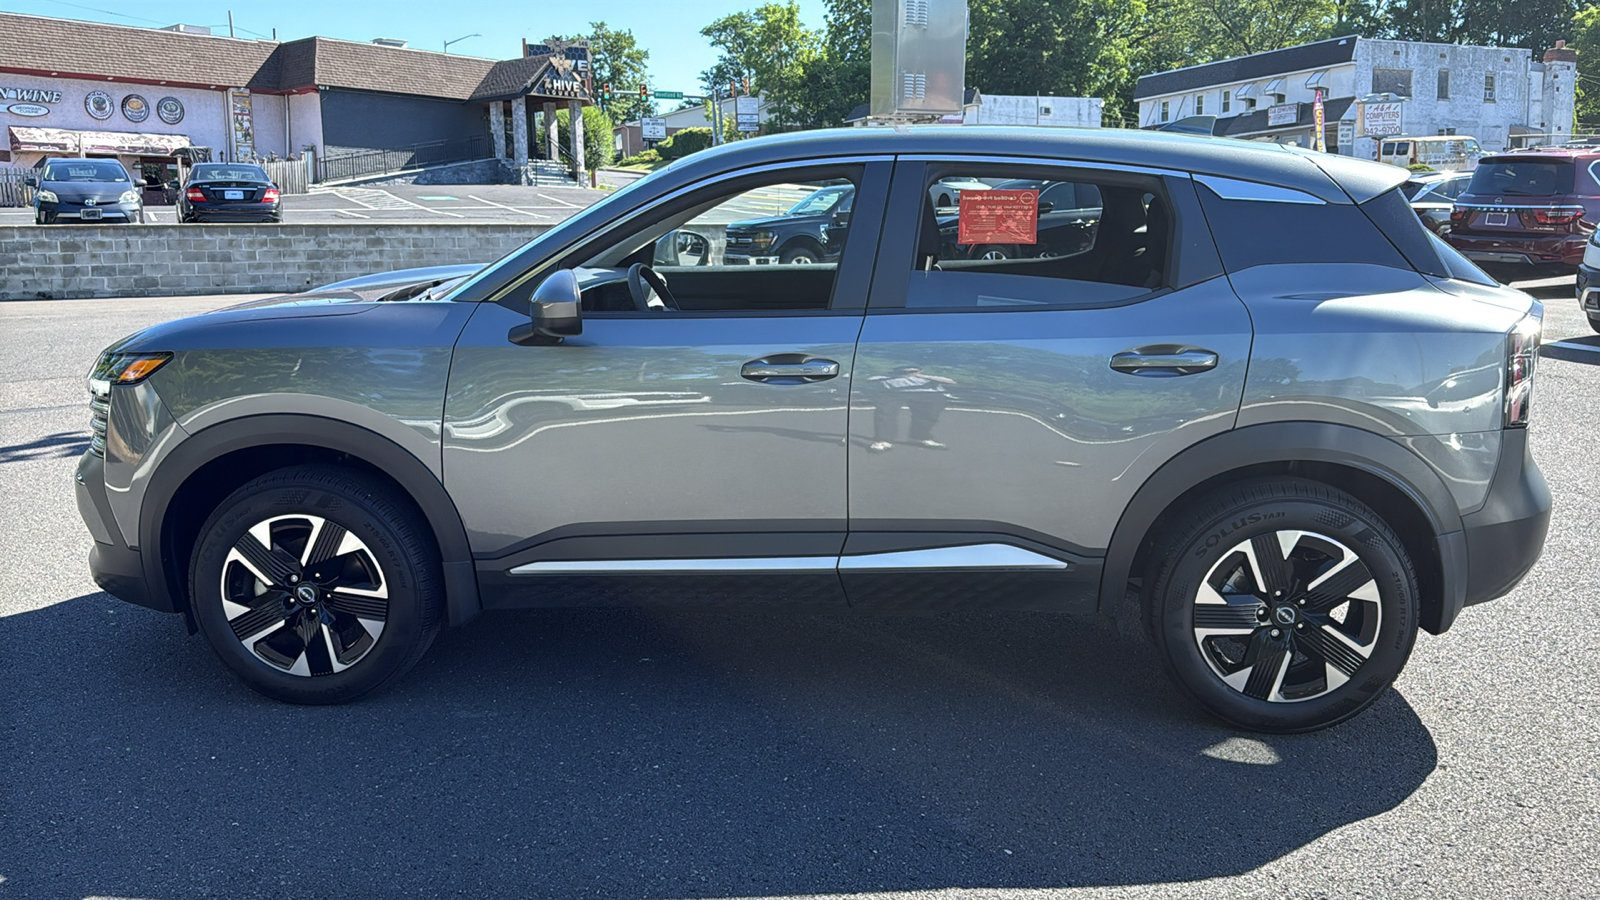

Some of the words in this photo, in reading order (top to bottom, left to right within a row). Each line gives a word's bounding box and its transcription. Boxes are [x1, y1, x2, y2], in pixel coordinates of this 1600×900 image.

[553, 79, 580, 92] HIVE
[16, 88, 62, 104] WINE
[1365, 111, 1400, 120] COMPUTERS
[1364, 125, 1401, 136] 942-9700
[1195, 512, 1262, 558] SOLUS
